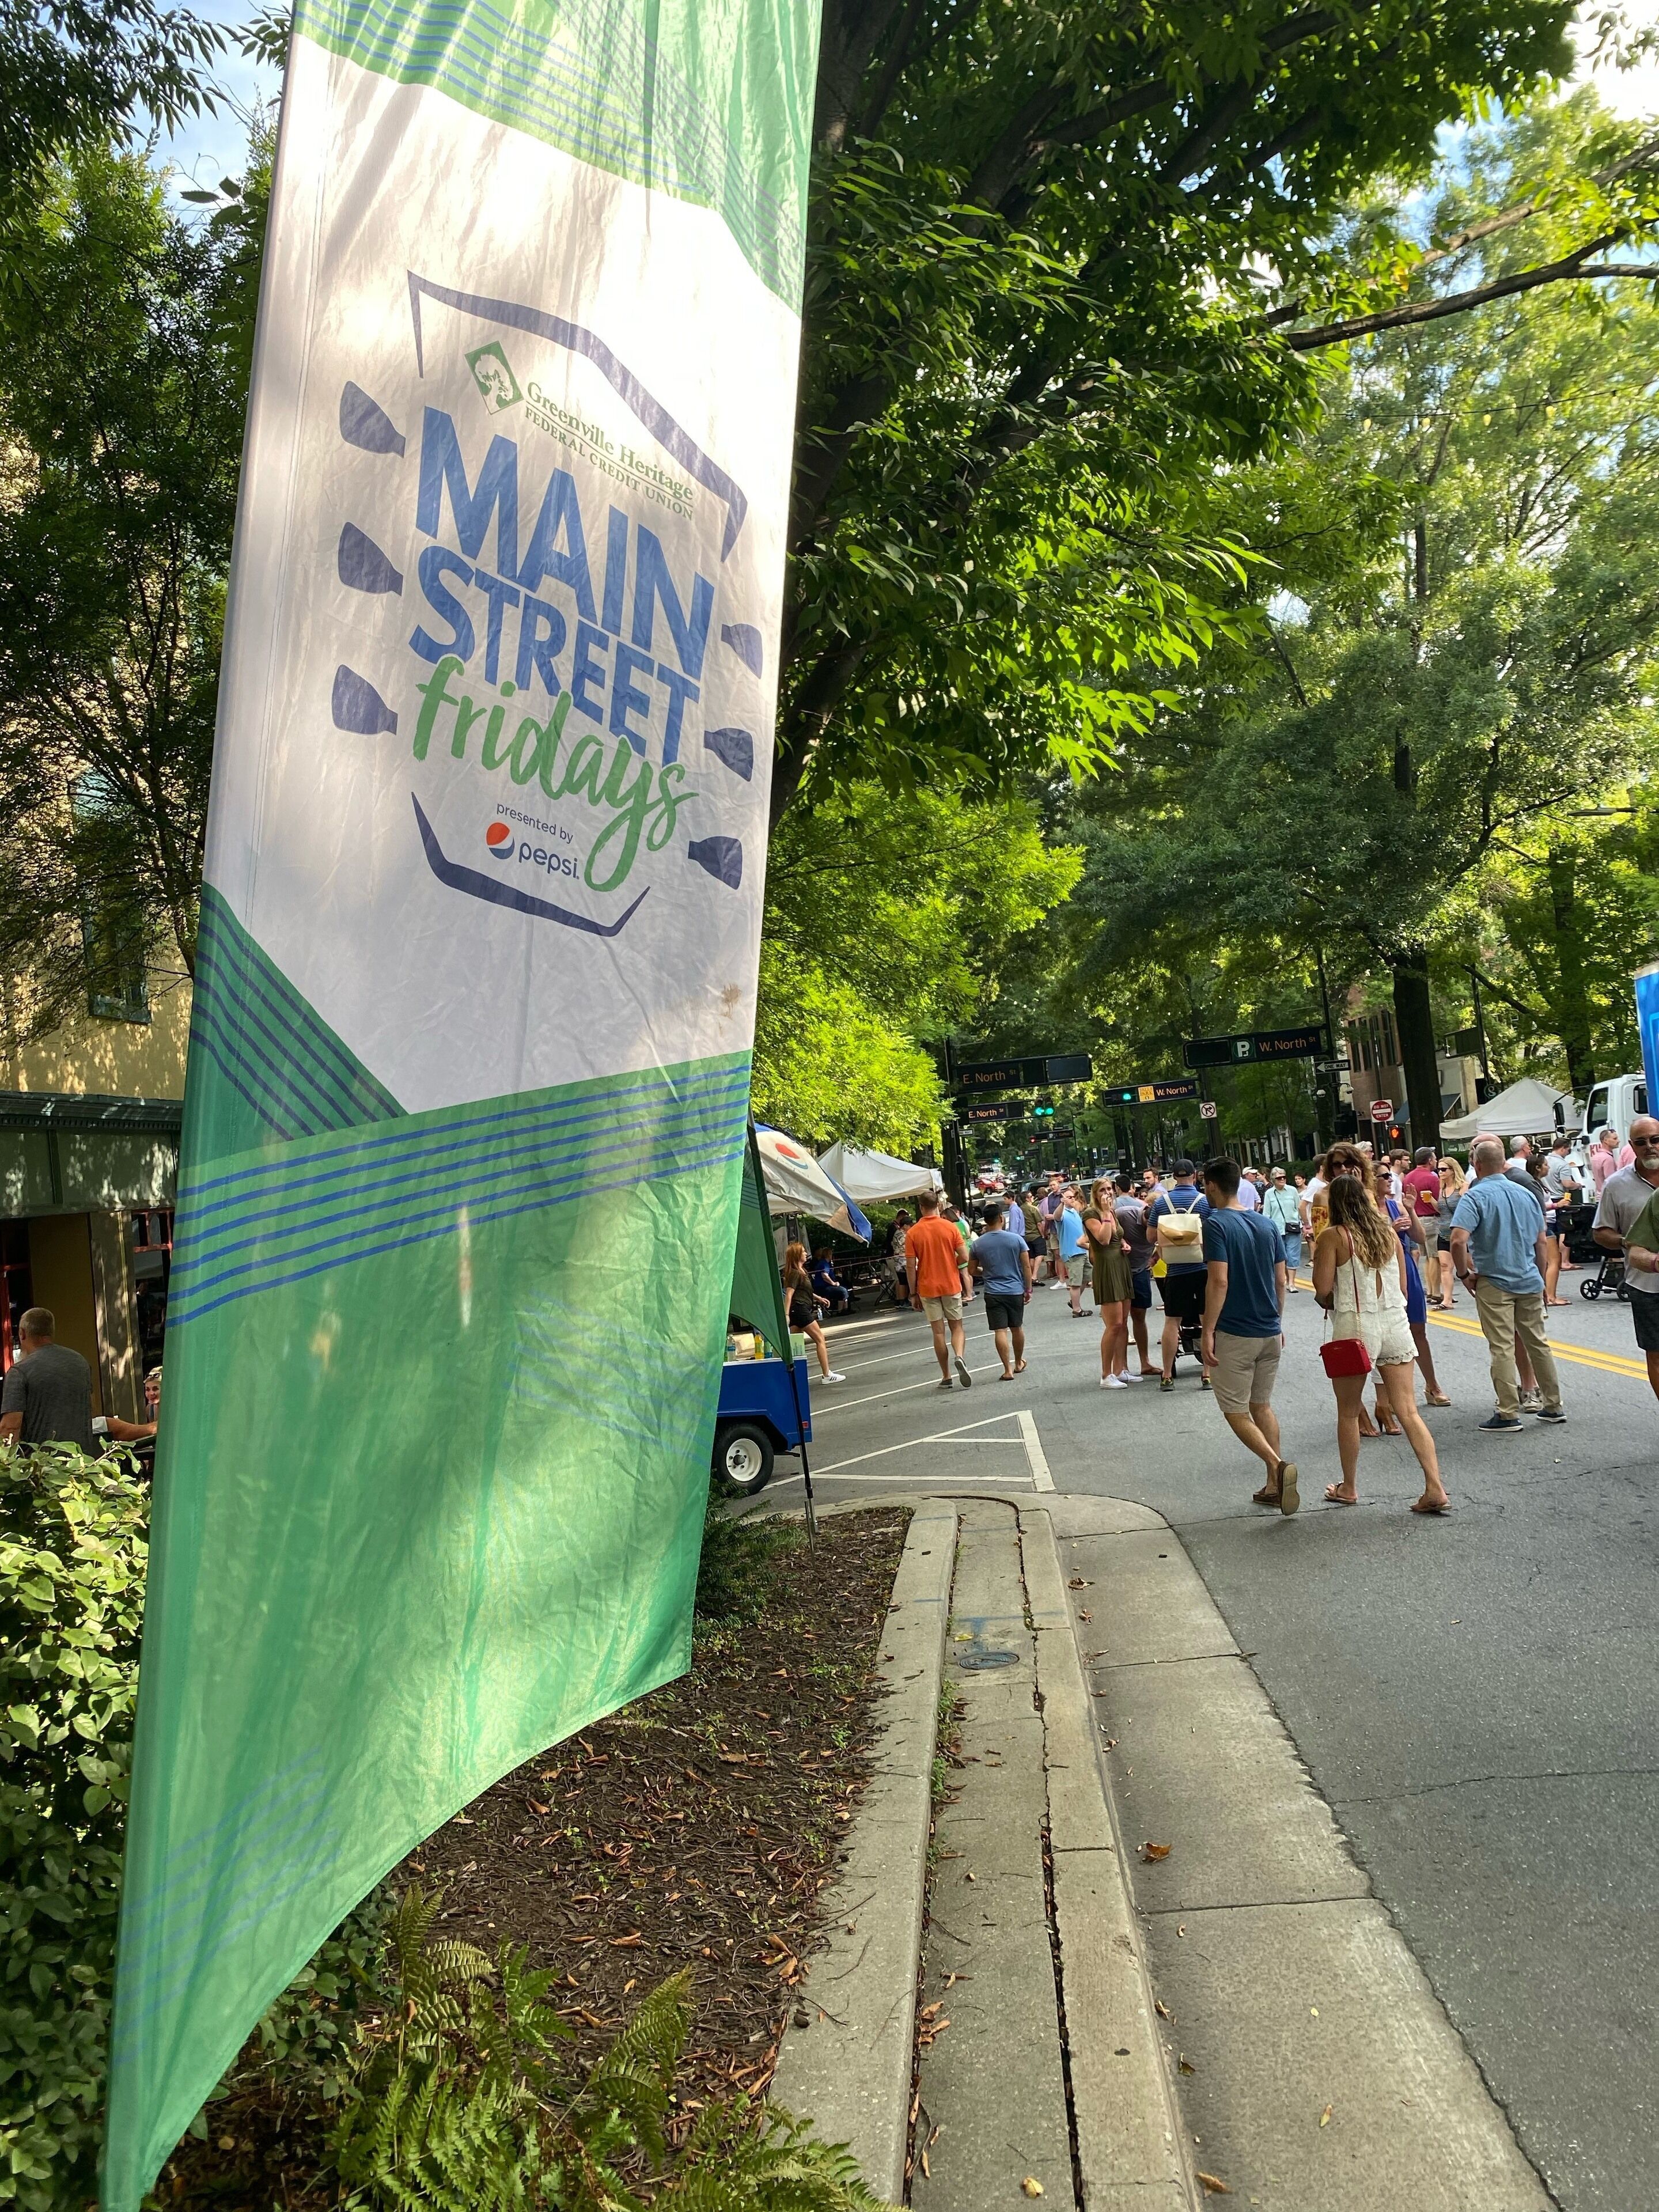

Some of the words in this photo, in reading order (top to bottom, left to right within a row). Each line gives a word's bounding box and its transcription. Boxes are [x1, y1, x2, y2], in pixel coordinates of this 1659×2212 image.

[525, 406, 586, 457] FEDERAL
[589, 452, 641, 492] CREDIT
[645, 486, 693, 521] UNION
[527, 381, 614, 456] Greenville
[619, 444, 694, 501] Heritage
[415, 405, 715, 683] MAIN
[408, 545, 700, 768] STREET
[412, 656, 700, 892] fridays
[497, 803, 556, 836] presented
[559, 826, 574, 844] by
[963, 1074, 973, 1084] E.
[975, 1070, 1006, 1083] North
[1259, 1041, 1272, 1052] W.
[1274, 1038, 1306, 1051] North
[968, 1111, 976, 1119] E.
[976, 1109, 997, 1118] North
[1166, 1086, 1188, 1095] North
